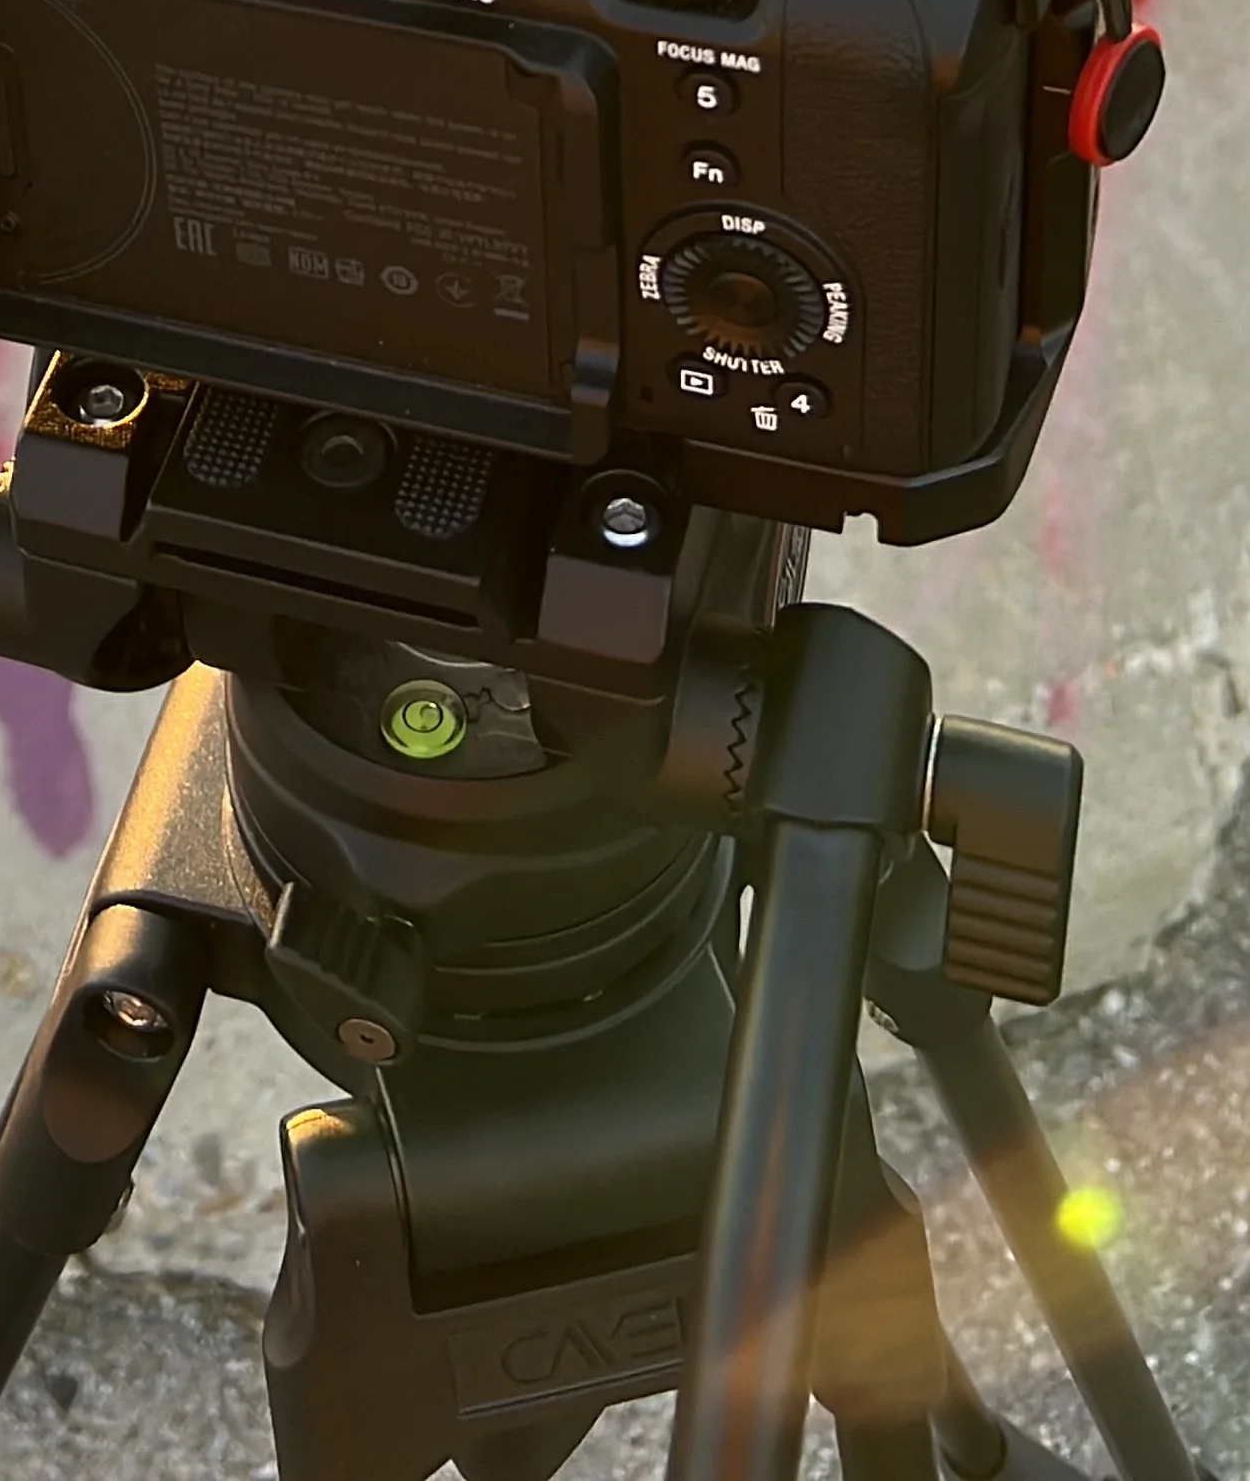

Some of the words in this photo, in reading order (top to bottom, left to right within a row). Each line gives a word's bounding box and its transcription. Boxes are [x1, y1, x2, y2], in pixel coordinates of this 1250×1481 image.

[657, 40, 715, 65] FOCUS
[720, 52, 762, 73] MAG
[696, 85, 718, 109] 5
[692, 161, 725, 184] Fn
[721, 215, 766, 235] DISP
[639, 254, 662, 301] ZEBRA
[822, 282, 850, 344] PEAKING
[702, 346, 785, 376] SHUTTER
[790, 394, 811, 414] 4
